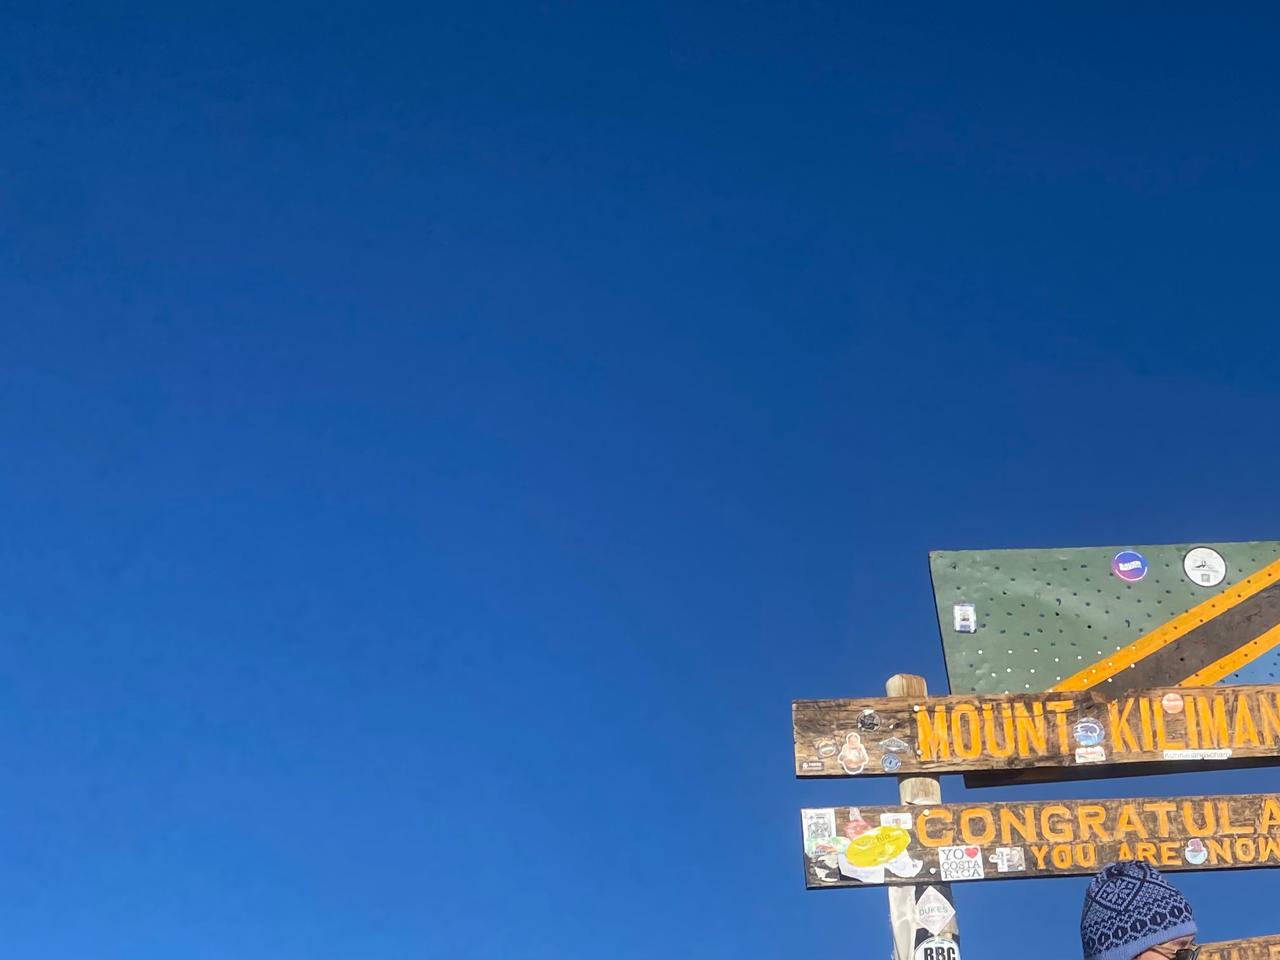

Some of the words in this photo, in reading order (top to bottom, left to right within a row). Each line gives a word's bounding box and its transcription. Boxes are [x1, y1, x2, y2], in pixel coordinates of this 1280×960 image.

[915, 700, 1076, 762] MOUNT
[941, 848, 964, 860] YO
[1031, 842, 1097, 870] YOU
[1117, 841, 1184, 867] ARE
[941, 861, 981, 871] COSTA
